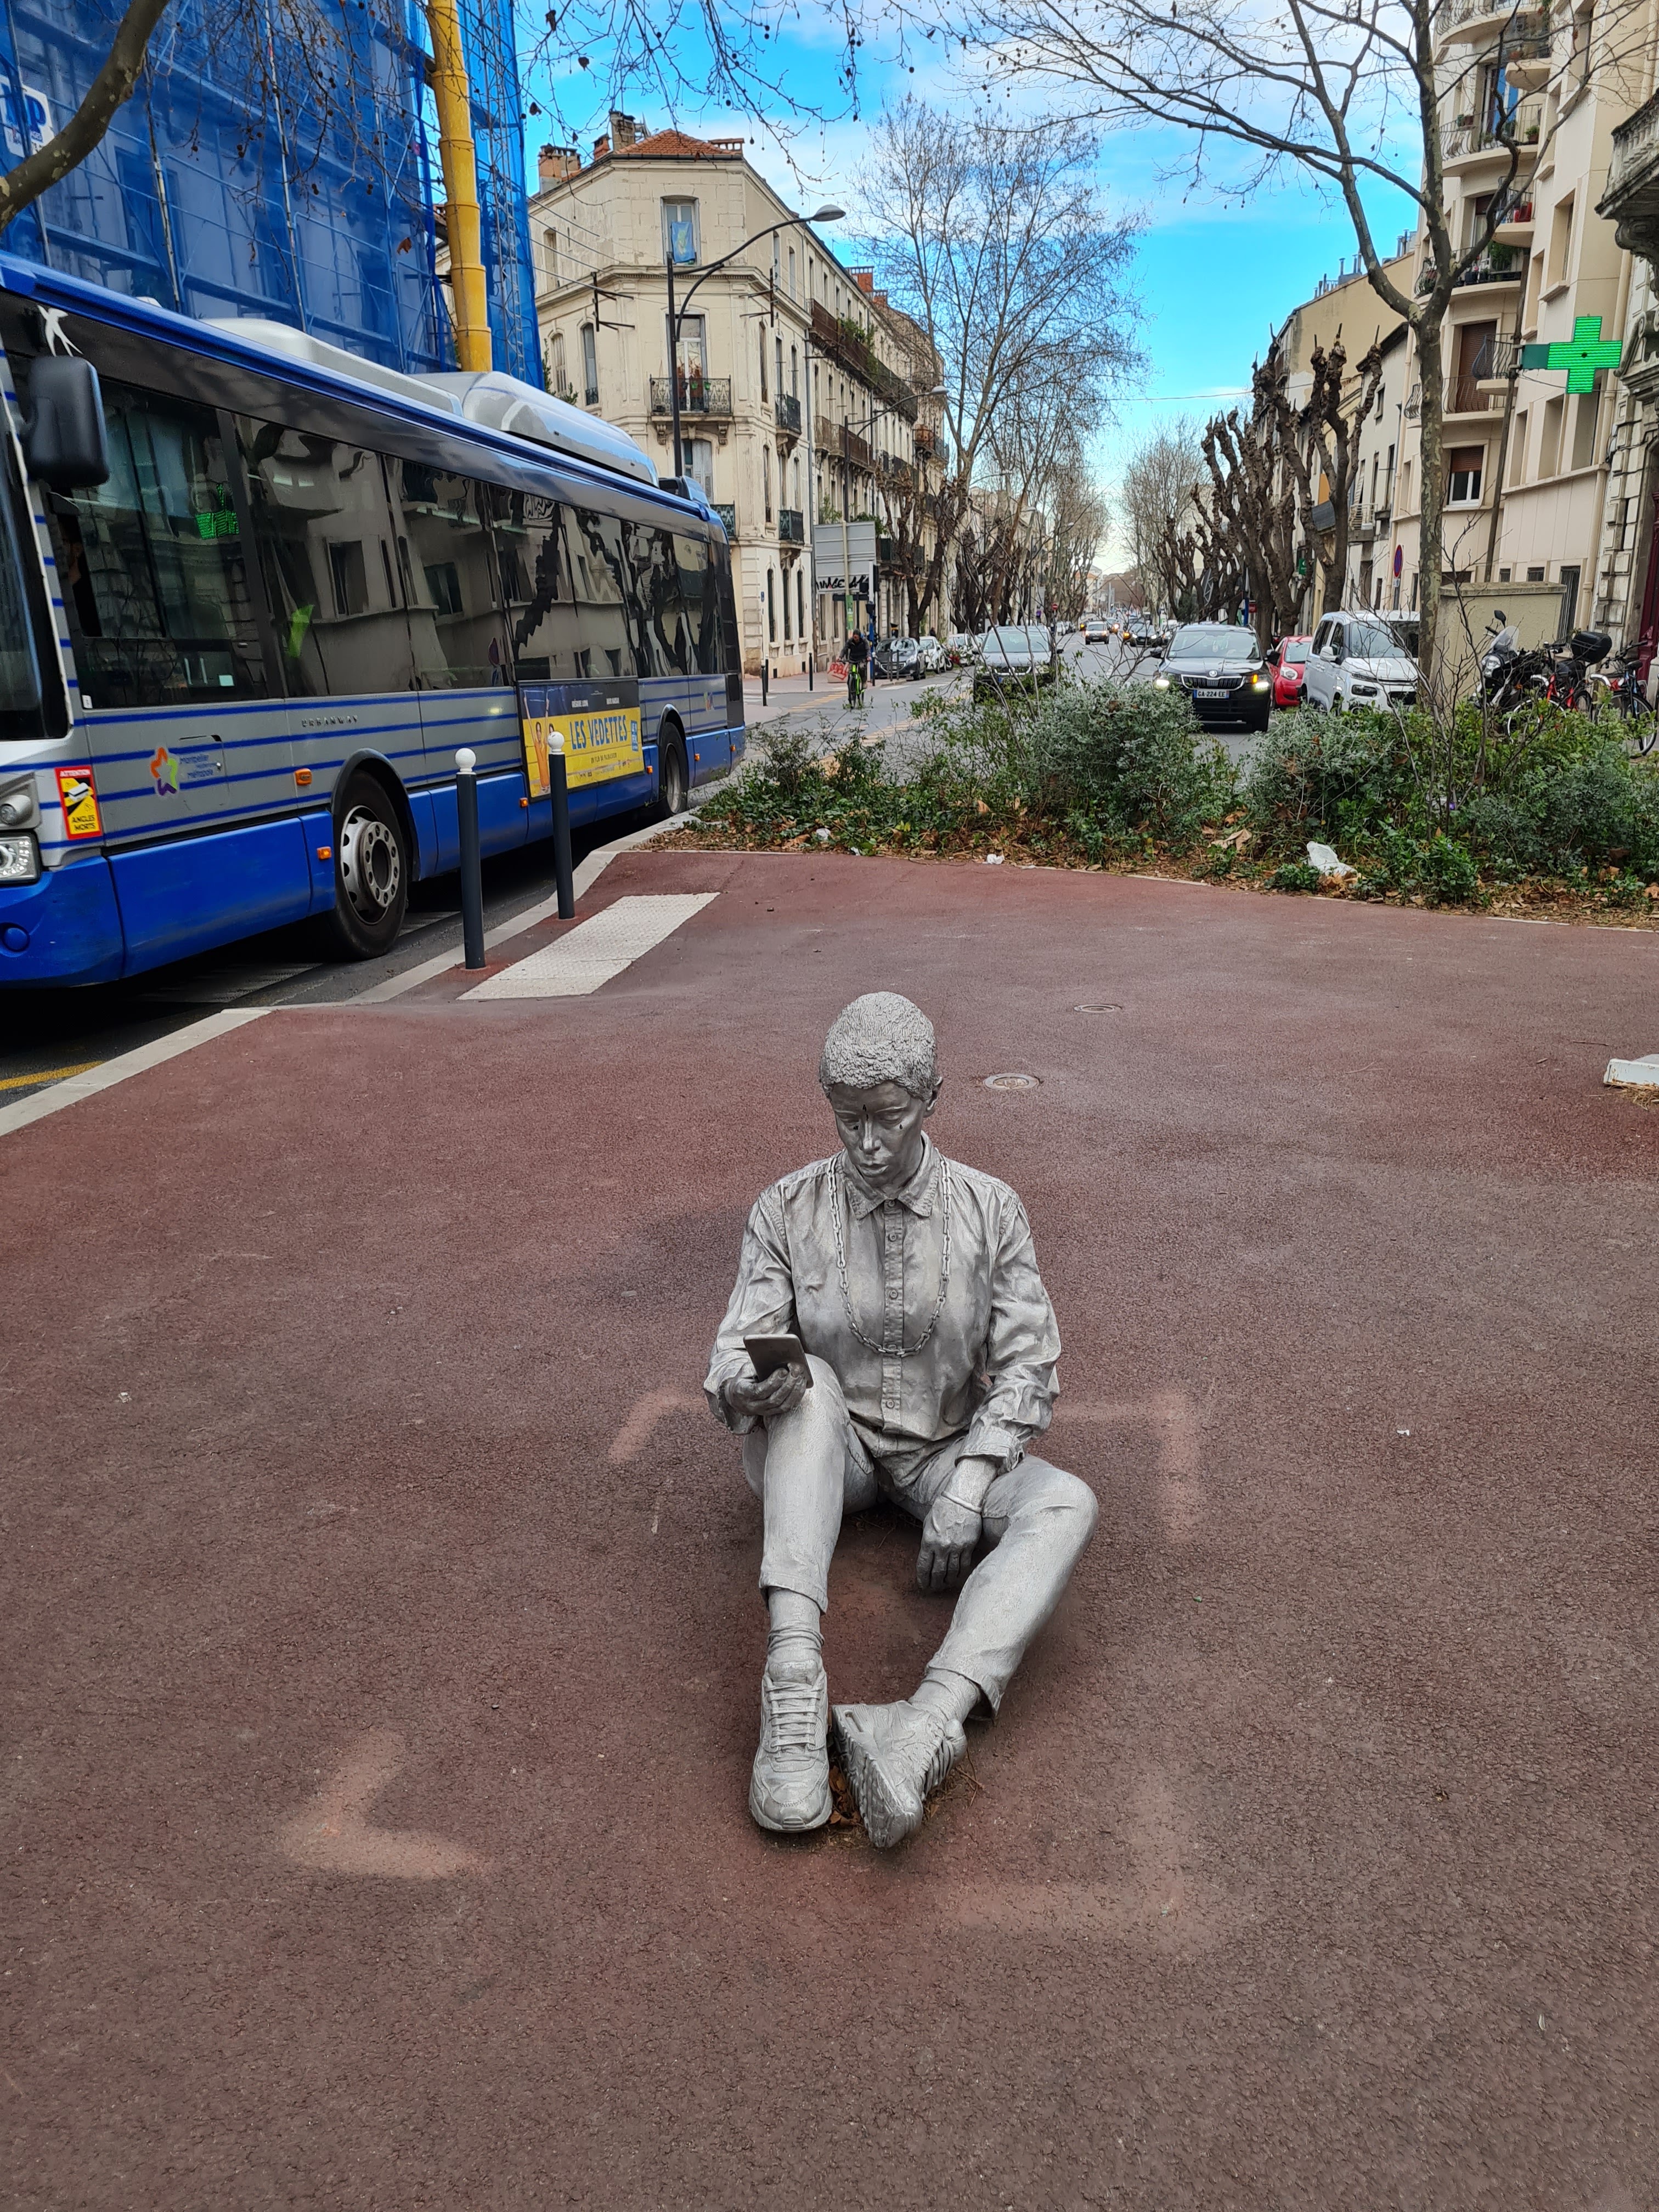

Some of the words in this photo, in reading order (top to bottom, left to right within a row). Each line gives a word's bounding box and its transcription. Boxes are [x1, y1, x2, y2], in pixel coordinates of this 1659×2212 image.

[569, 720, 586, 750] LES
[588, 715, 627, 747] VEDETTES
[72, 815, 95, 823] ANGLES
